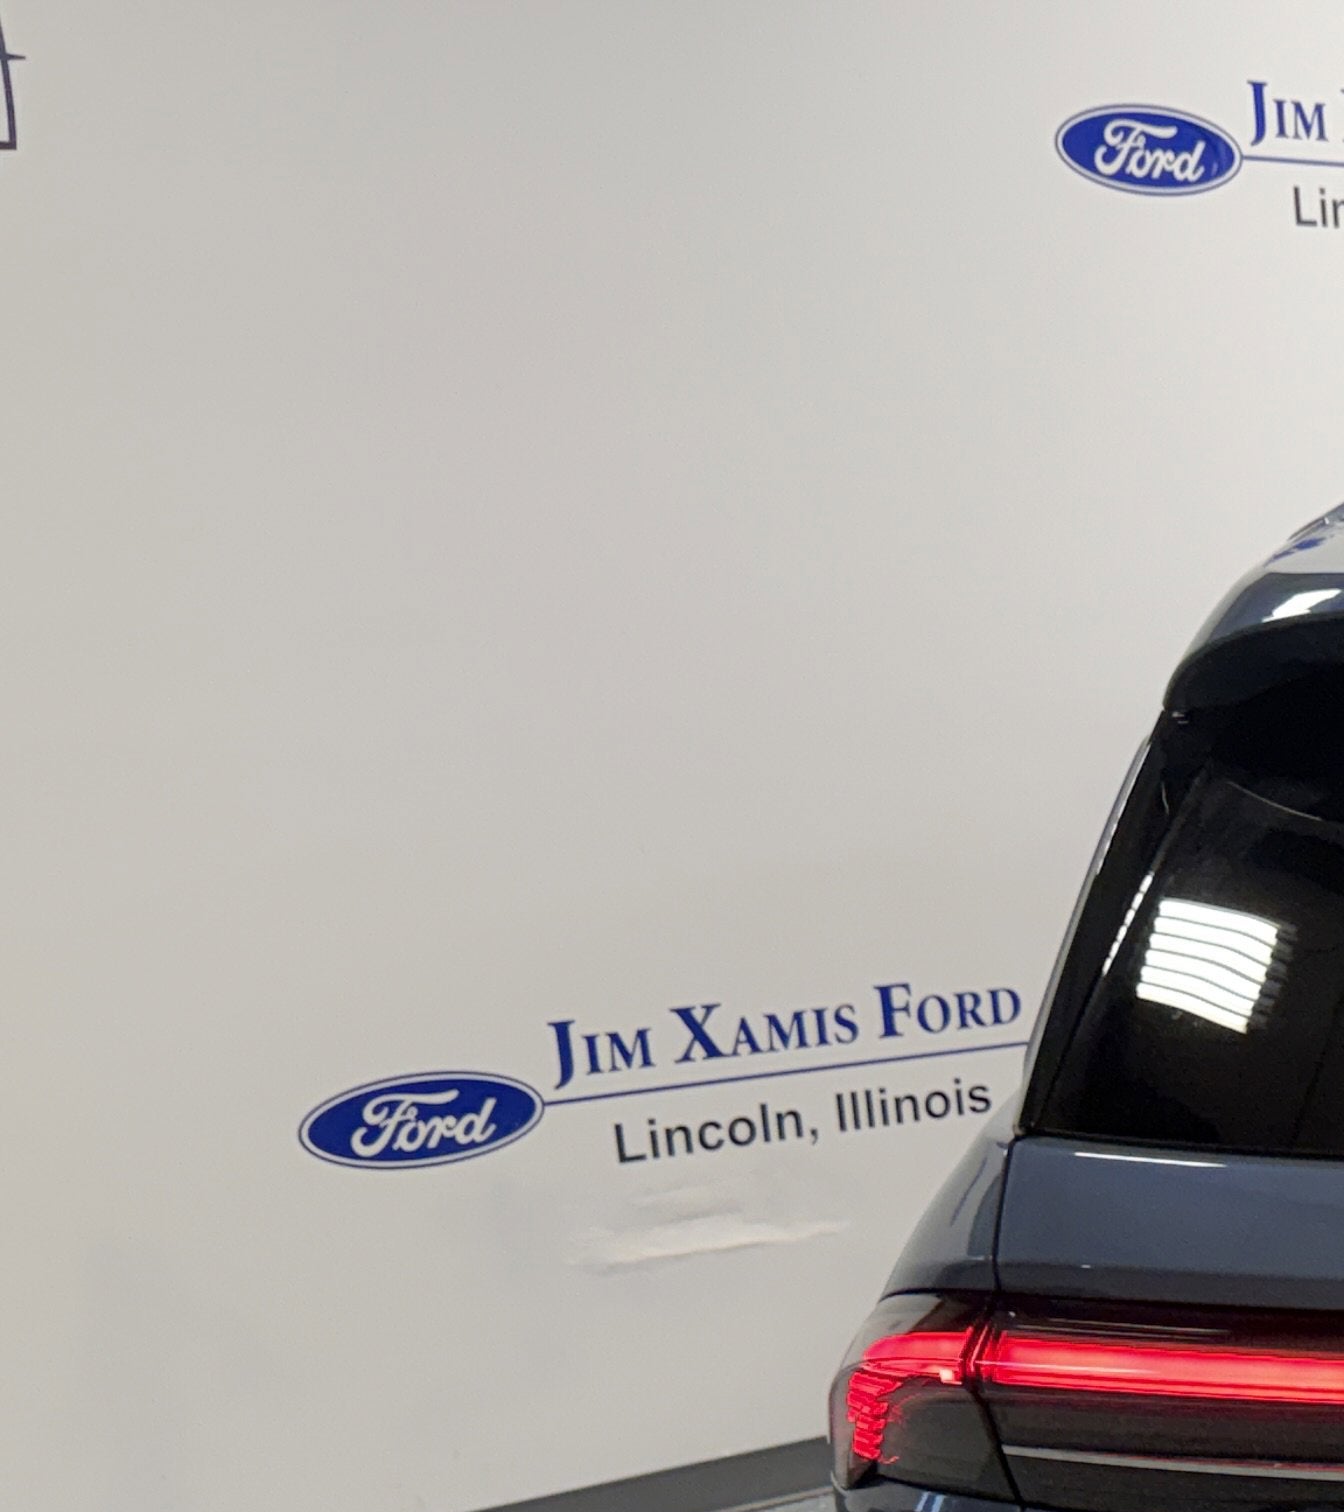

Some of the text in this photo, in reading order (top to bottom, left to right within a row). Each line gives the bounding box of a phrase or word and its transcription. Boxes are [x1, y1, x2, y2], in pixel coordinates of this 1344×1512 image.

[1247, 80, 1329, 147] JIM
[1093, 118, 1206, 184] Ford
[547, 982, 1023, 1090] JIM XAMIS FORD
[350, 1088, 497, 1159] Ford
[613, 1077, 992, 1164] Lincoln, Illinois
